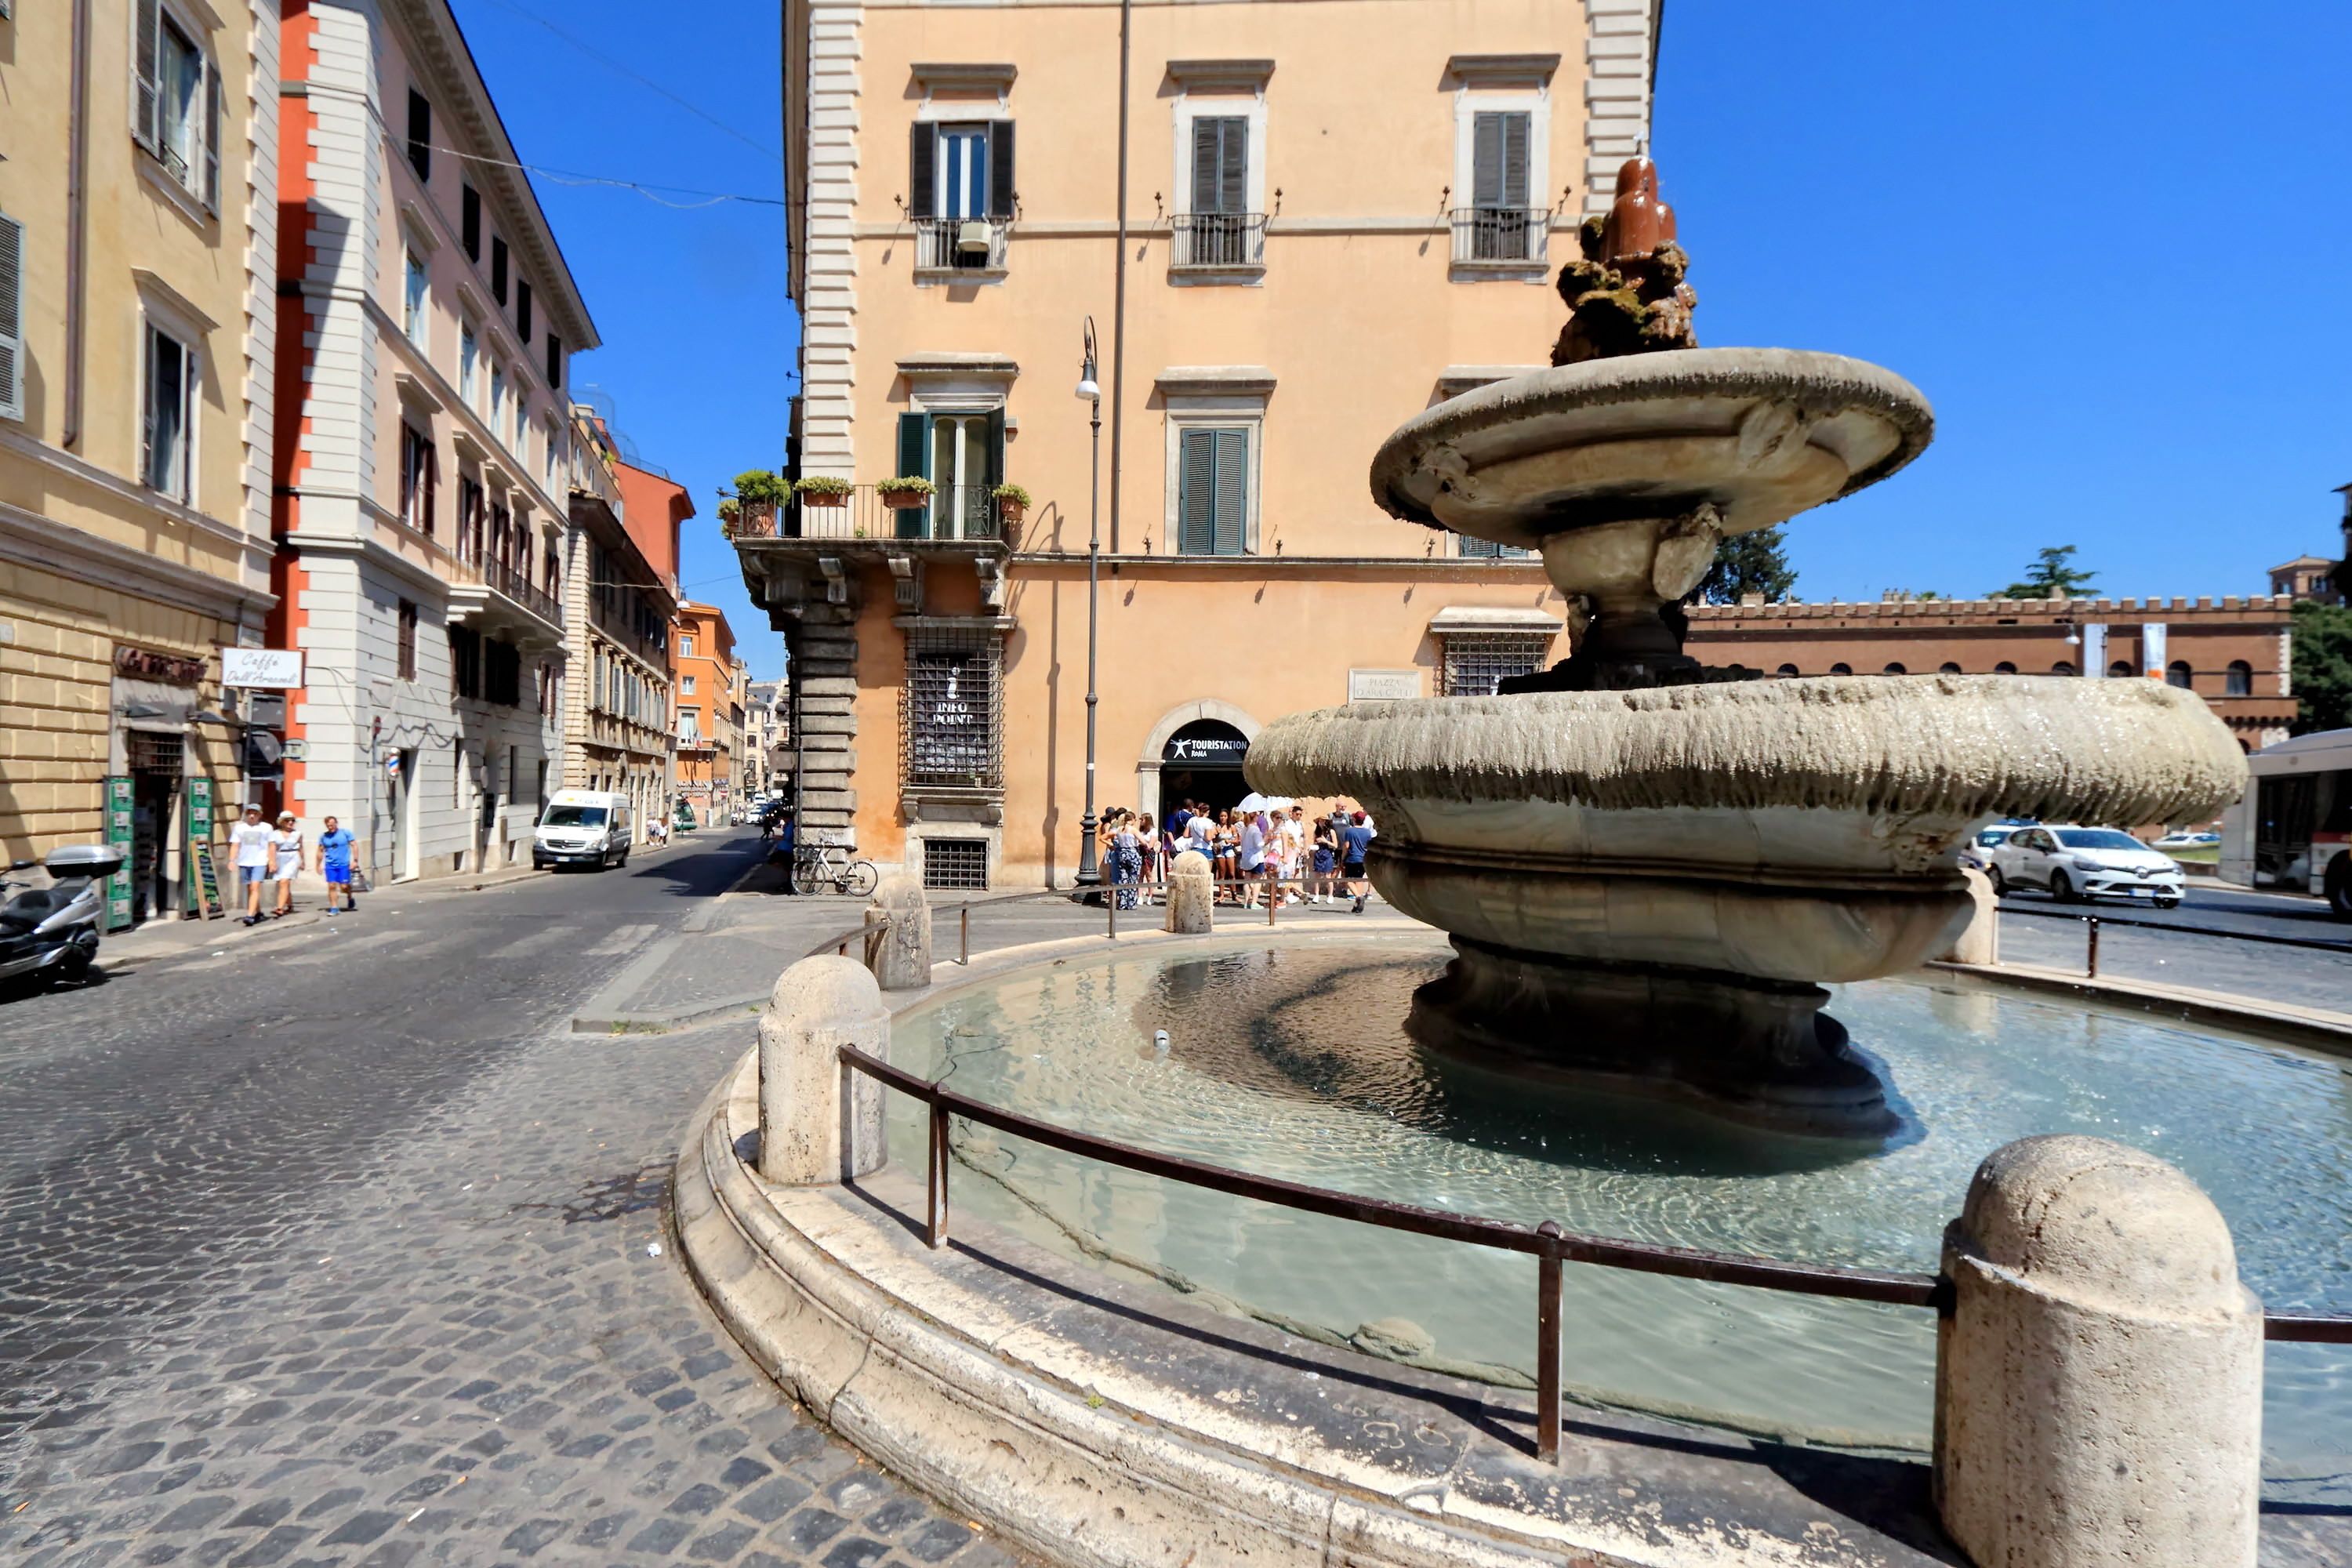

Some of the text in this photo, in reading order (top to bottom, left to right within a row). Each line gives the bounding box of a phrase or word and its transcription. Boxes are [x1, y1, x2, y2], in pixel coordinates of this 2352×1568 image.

[1369, 678, 1399, 687] PIAZZA
[937, 702, 967, 713] INFO
[932, 714, 973, 725] POINT
[1191, 740, 1247, 750] TOURISTATION
